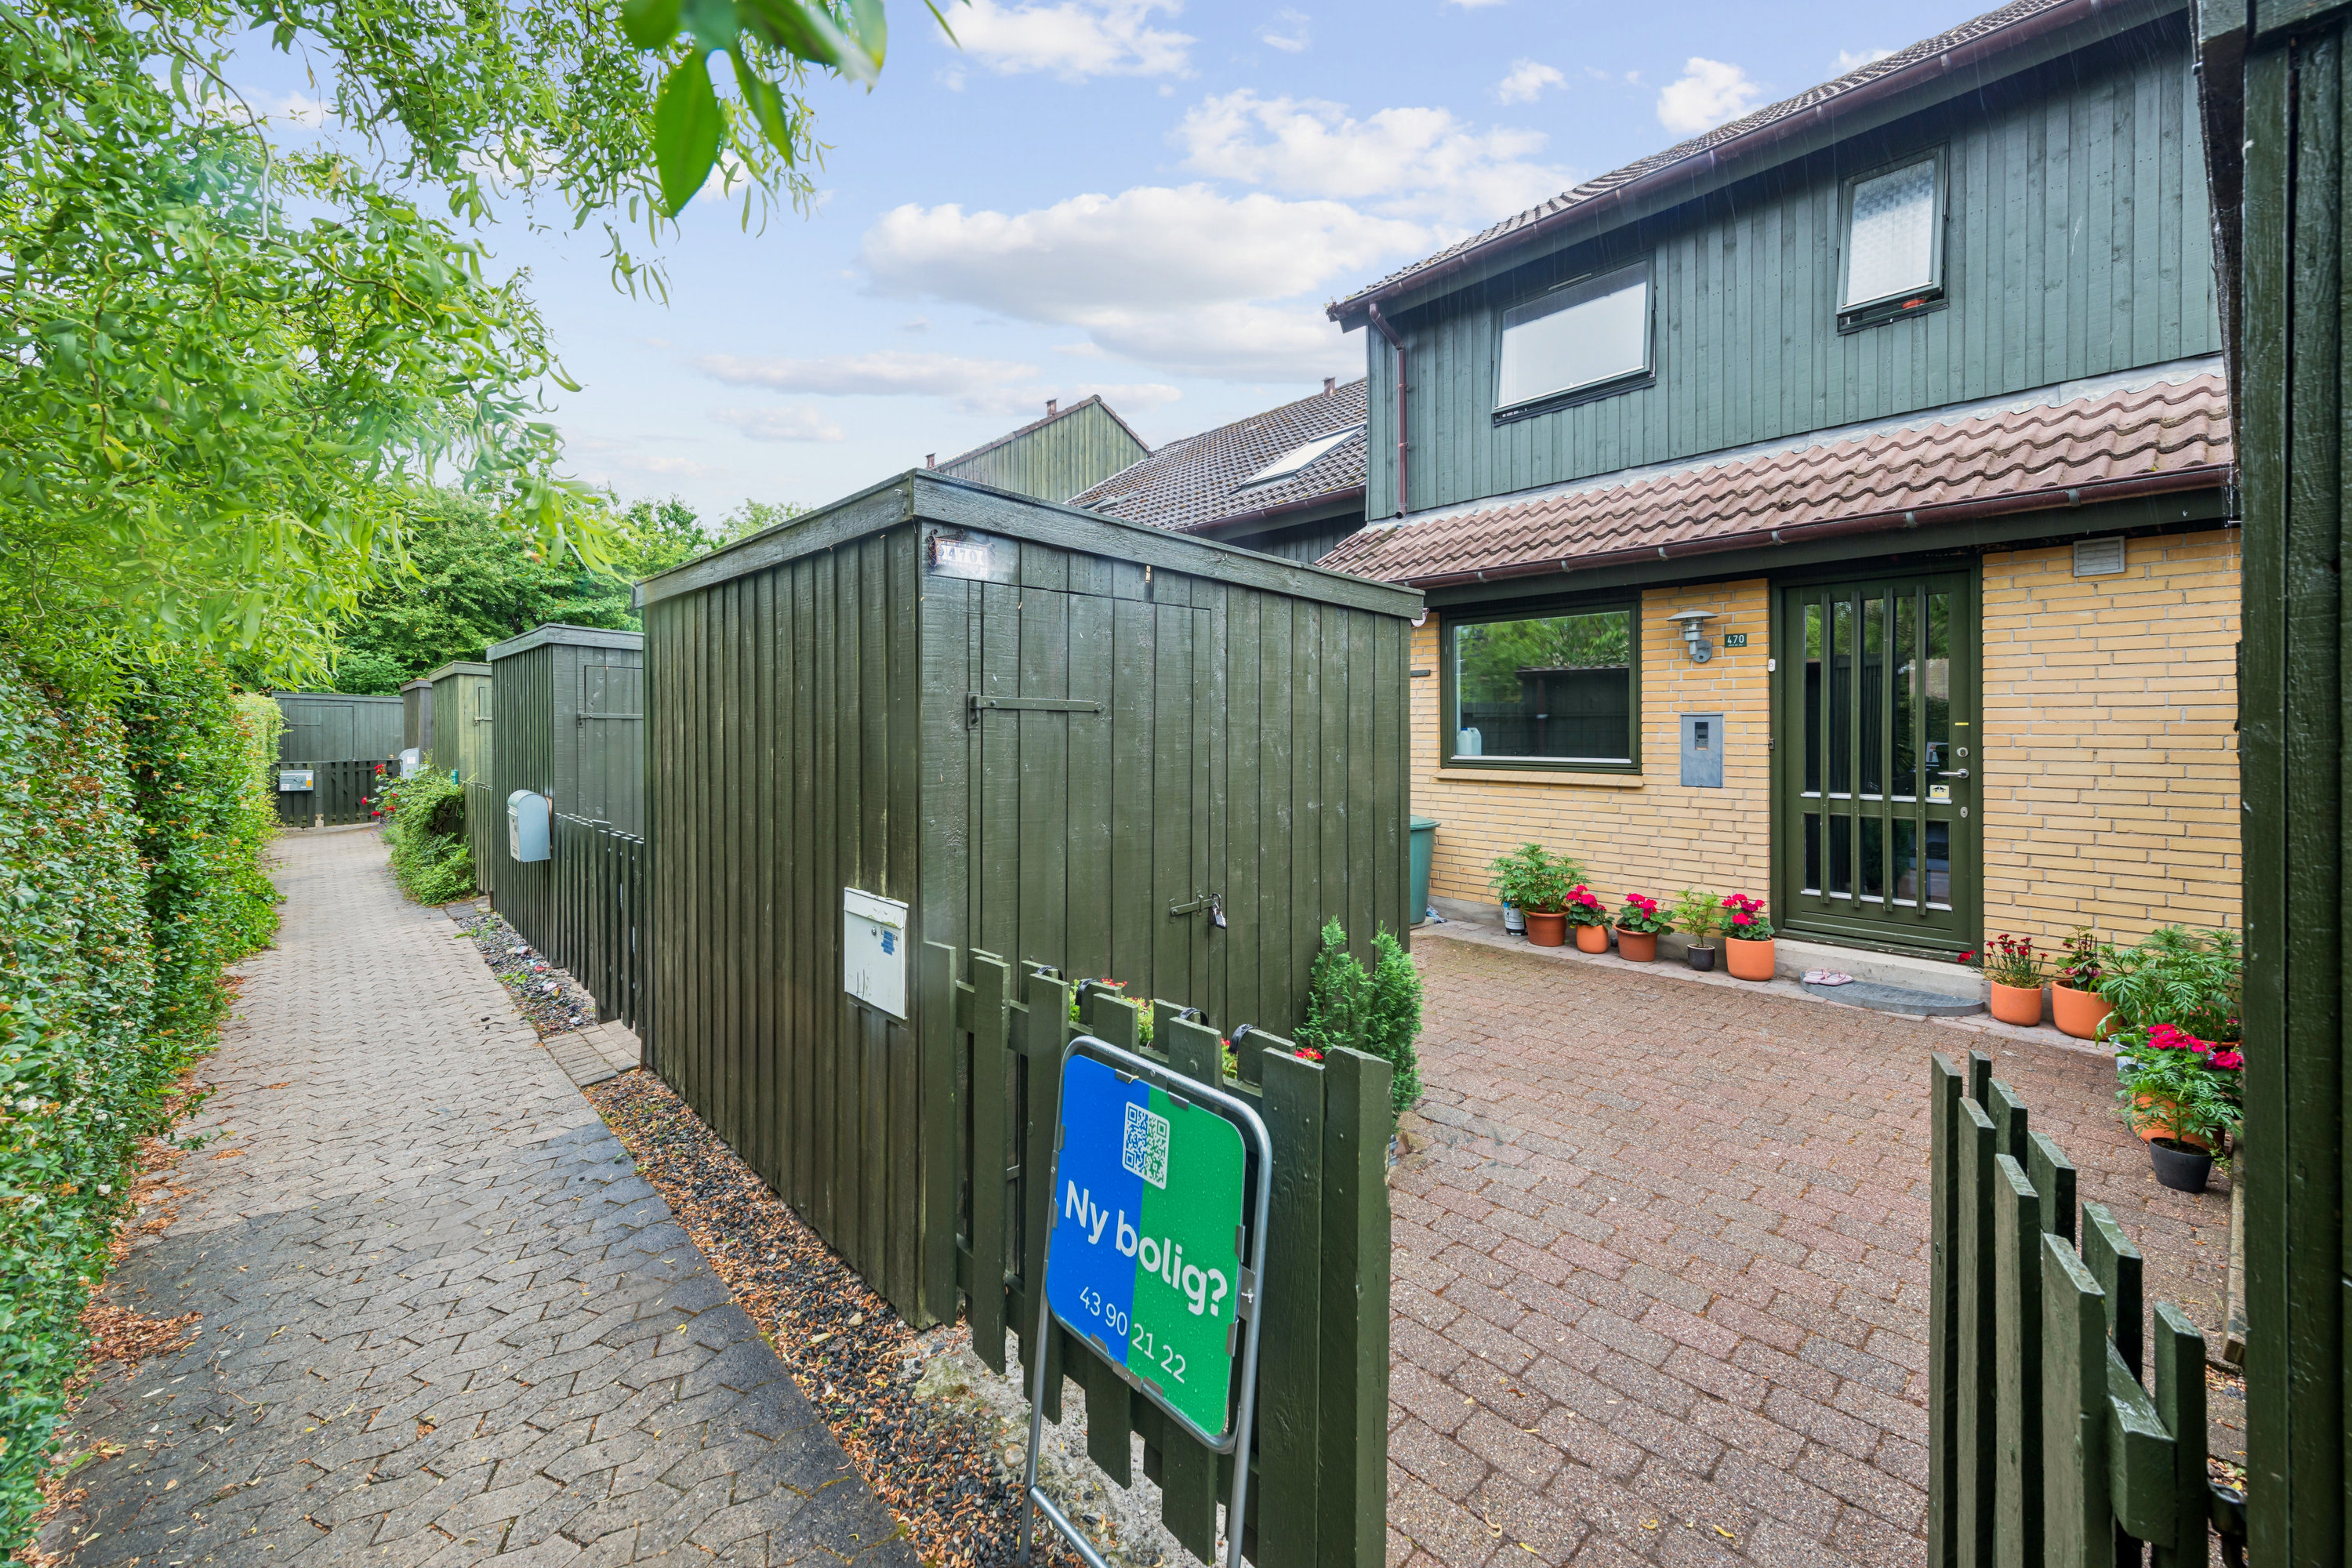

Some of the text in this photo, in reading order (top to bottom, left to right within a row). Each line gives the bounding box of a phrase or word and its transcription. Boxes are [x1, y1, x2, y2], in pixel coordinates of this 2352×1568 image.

[949, 547, 978, 563] 470
[1727, 634, 1744, 644] 470
[1065, 1180, 1228, 1316] Ny bolig?
[1080, 1286, 1186, 1384] 43 90 21 22
